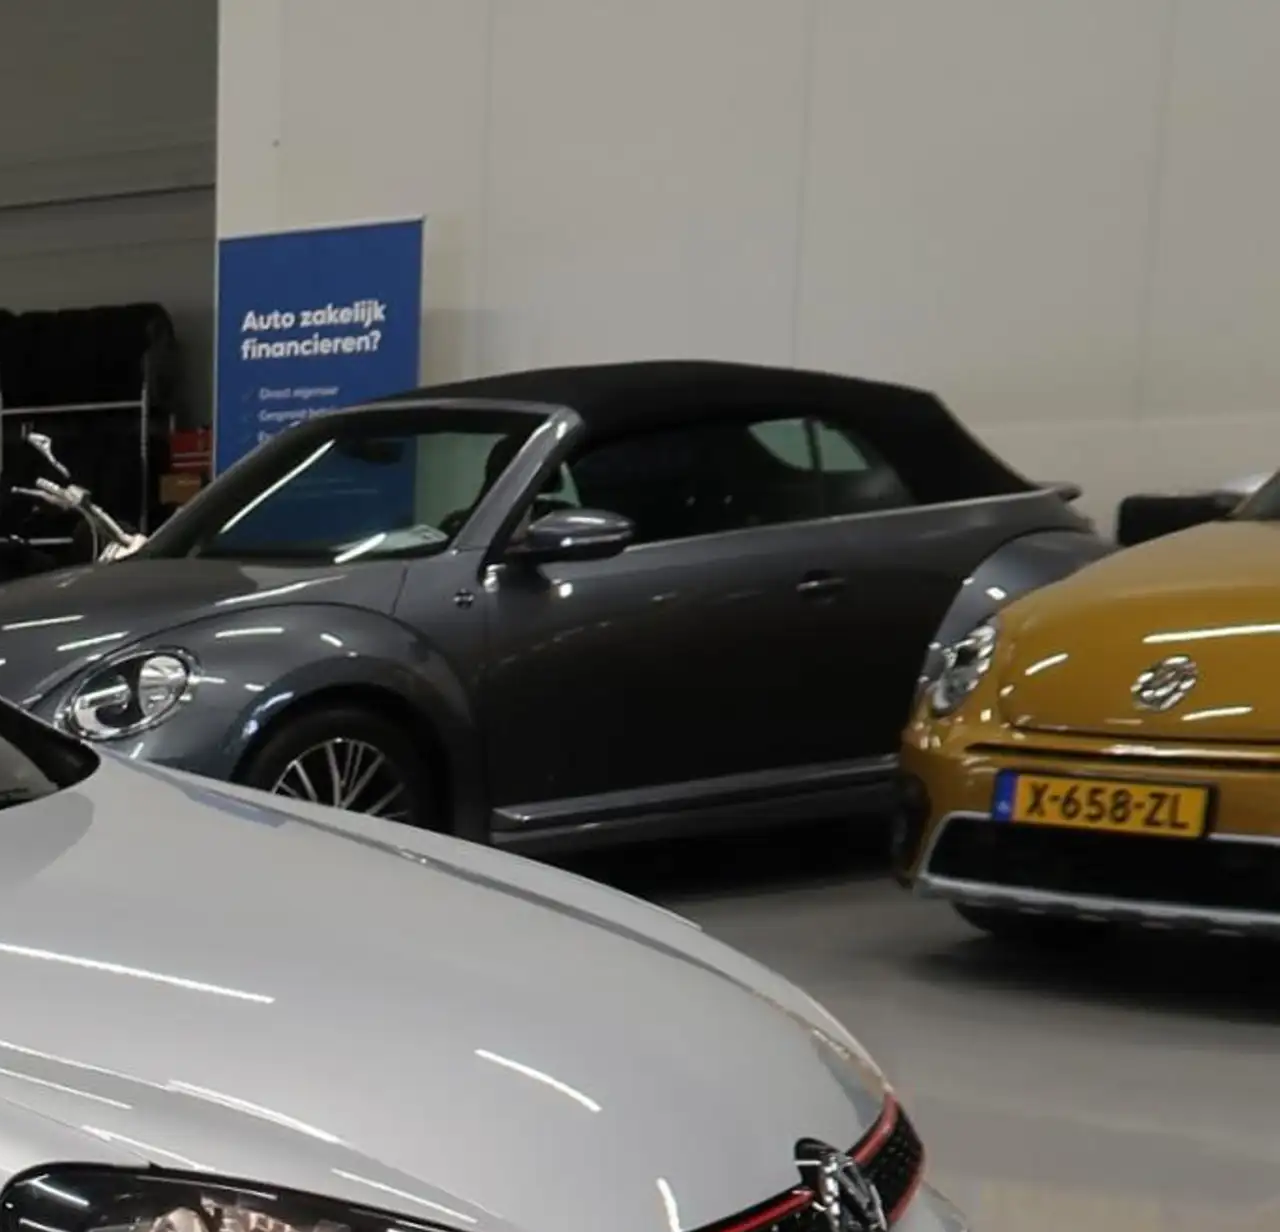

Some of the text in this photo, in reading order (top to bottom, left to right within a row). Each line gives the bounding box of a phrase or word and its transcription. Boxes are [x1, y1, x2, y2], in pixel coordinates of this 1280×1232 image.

[242, 299, 386, 332] Auto zakelijk
[242, 330, 381, 360] financieren?
[1026, 783, 1189, 830] X-658-ZL
